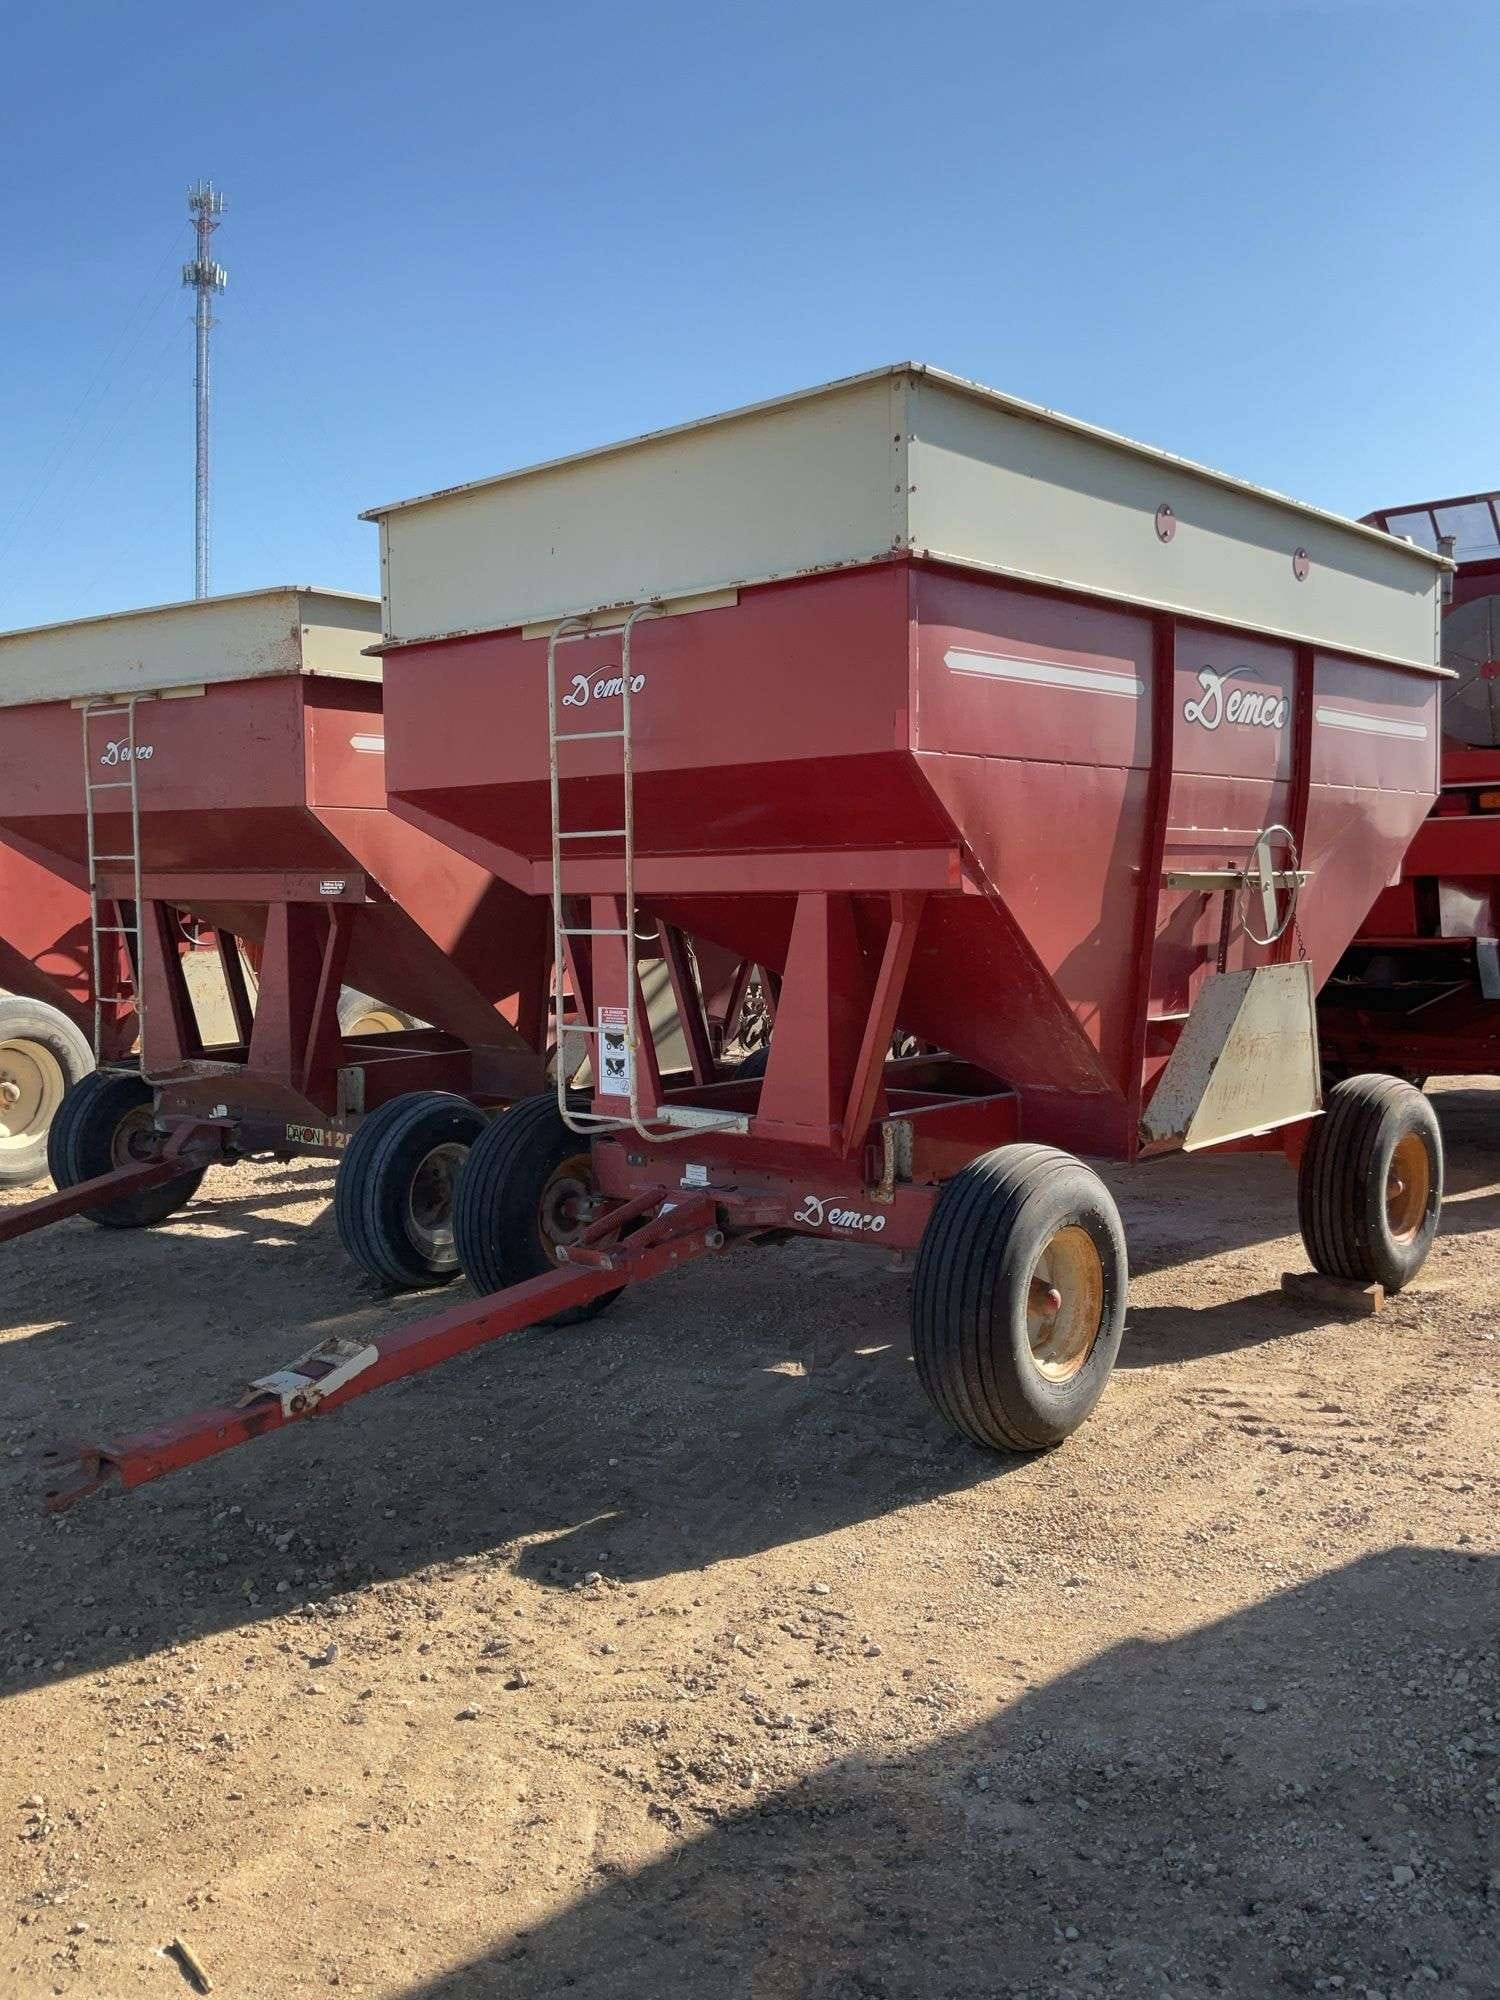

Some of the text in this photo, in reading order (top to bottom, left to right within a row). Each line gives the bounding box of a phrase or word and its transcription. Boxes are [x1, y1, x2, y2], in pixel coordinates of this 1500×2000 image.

[1184, 664, 1289, 730] Demco
[287, 1125, 321, 1144] DAKON
[793, 1195, 886, 1232] Demco
